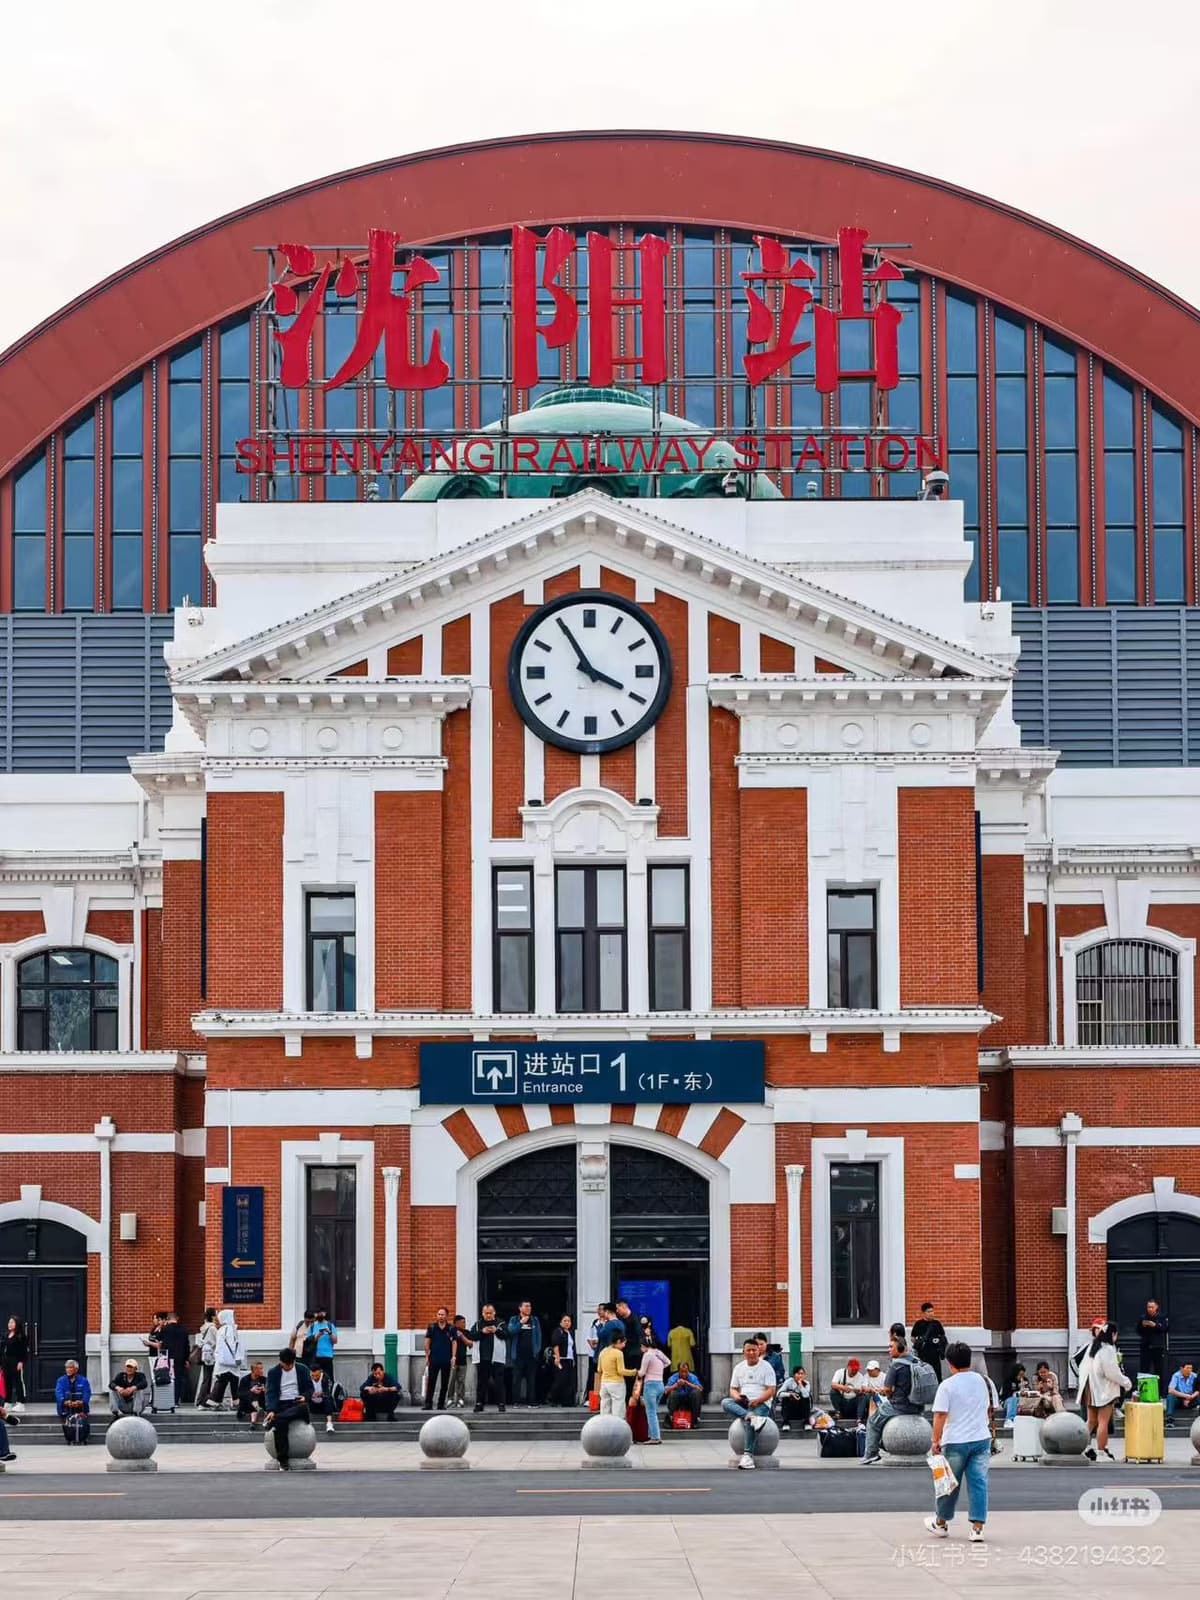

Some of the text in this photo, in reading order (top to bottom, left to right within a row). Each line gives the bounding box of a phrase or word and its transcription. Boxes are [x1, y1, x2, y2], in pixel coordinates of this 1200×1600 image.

[271, 225, 905, 393] 沈阳站
[236, 435, 944, 474] SHENYANG RAILWAY STATION
[523, 1052, 601, 1076] 进站口
[610, 1052, 627, 1091] 1
[523, 1081, 584, 1093] Entrance
